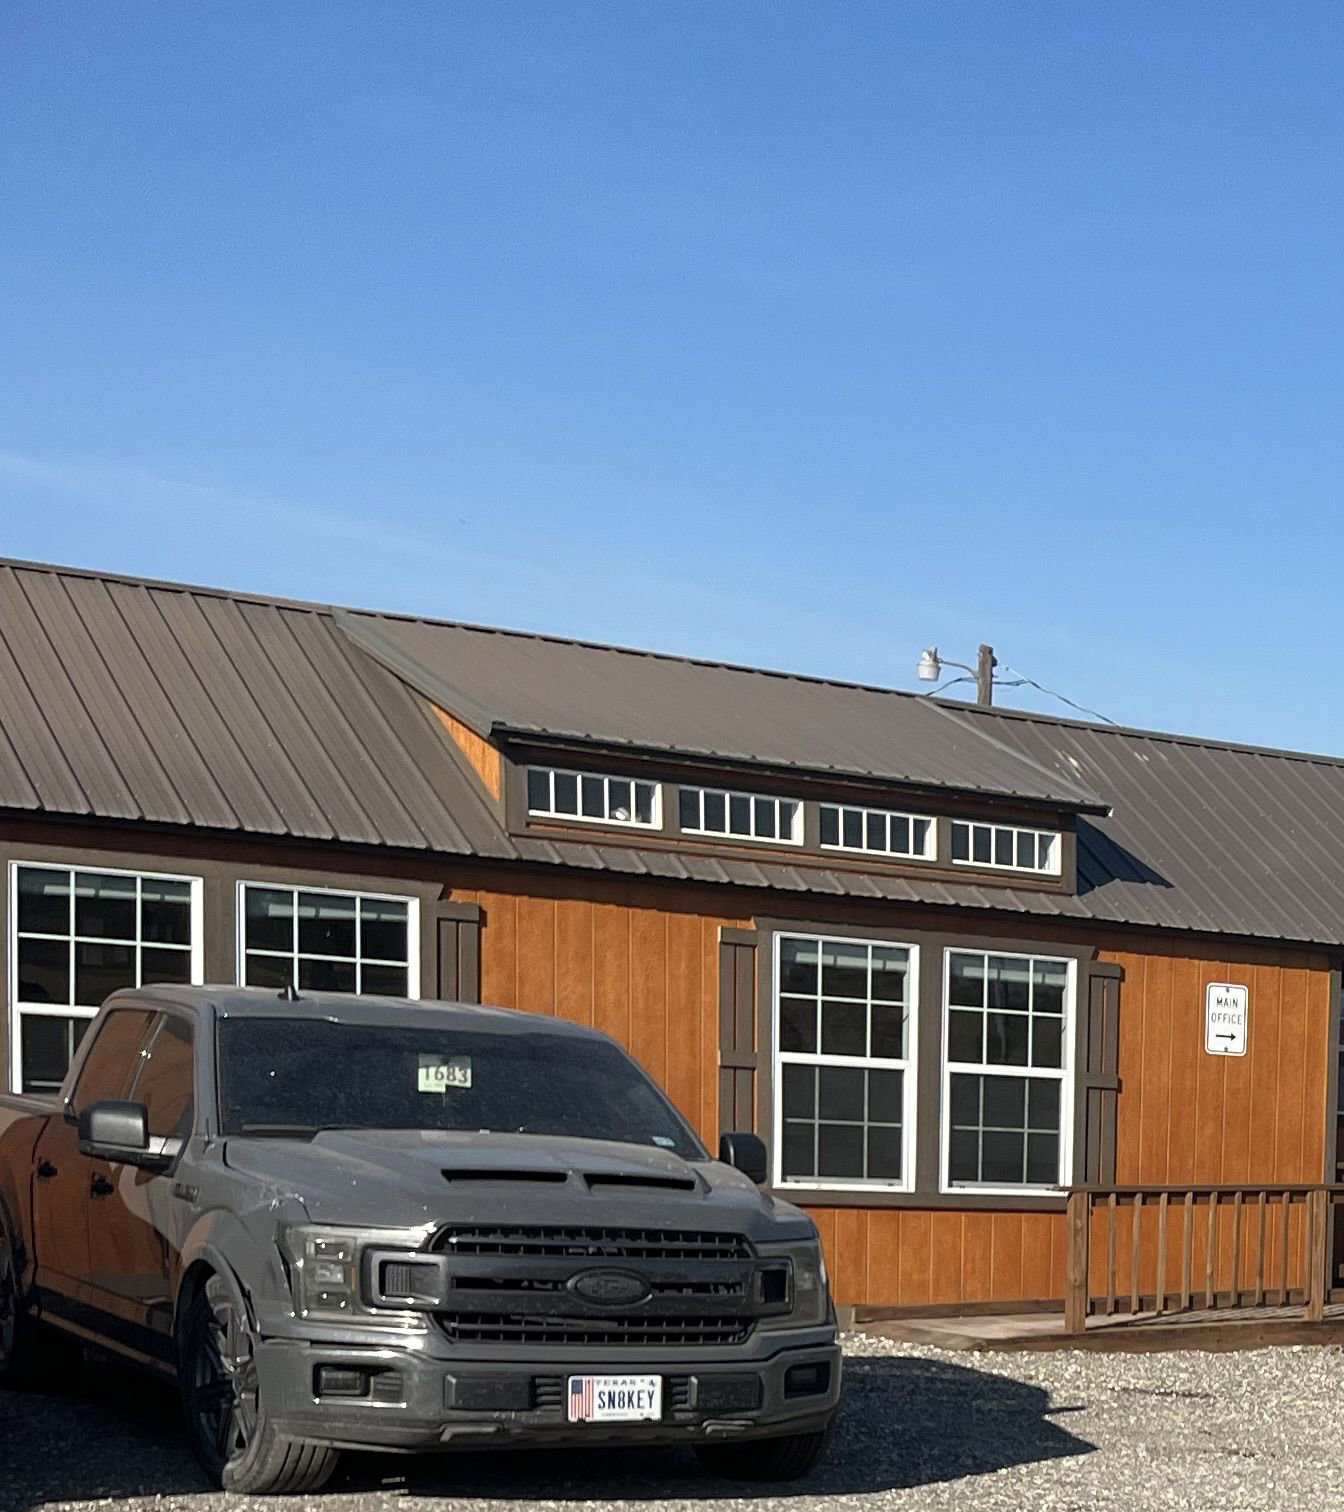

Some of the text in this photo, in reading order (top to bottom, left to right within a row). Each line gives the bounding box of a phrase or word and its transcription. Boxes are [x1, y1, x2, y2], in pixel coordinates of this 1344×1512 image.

[1216, 997, 1239, 1008] MAIN
[1211, 1012, 1242, 1025] OFFICE
[426, 1066, 468, 1084] 1683
[598, 1390, 655, 1410] SN8KEY
